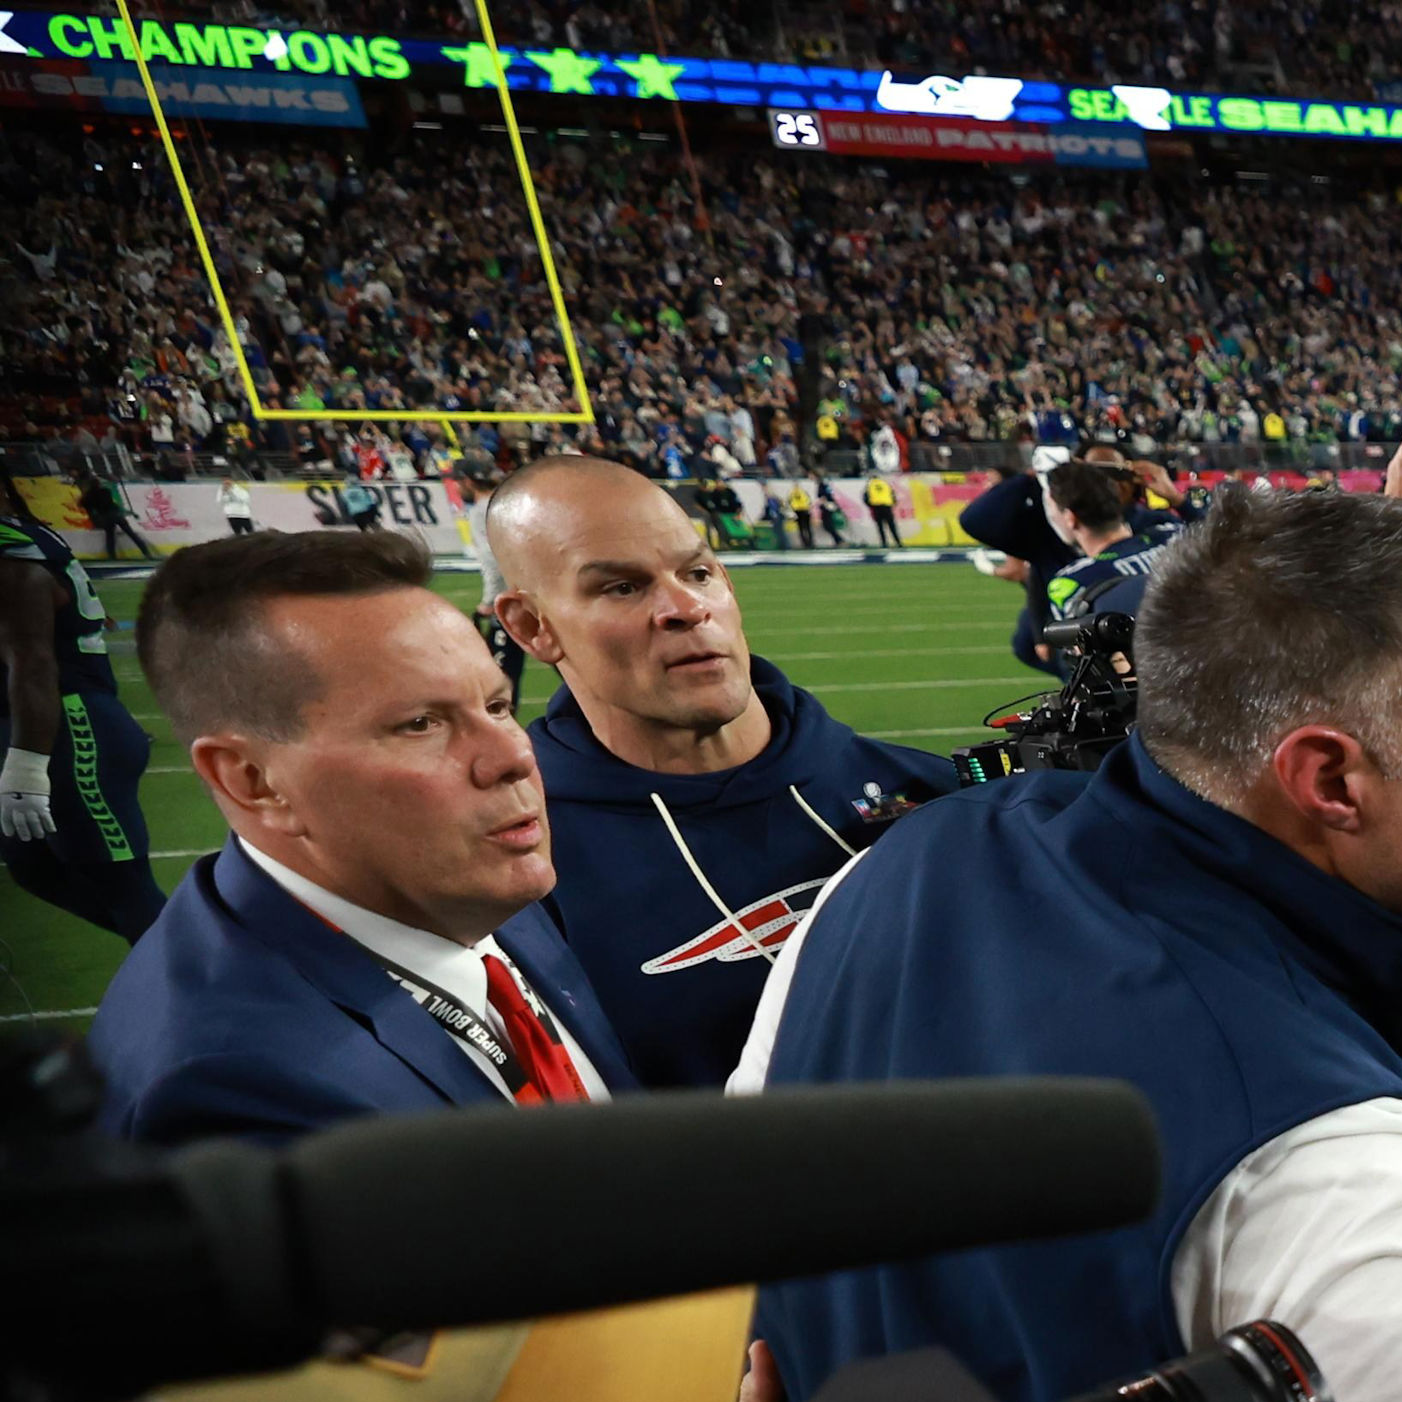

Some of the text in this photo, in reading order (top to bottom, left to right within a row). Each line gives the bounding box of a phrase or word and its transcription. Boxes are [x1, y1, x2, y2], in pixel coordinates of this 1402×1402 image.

[30, 73, 351, 114] SEAHAWKS
[776, 113, 822, 146] 25
[827, 121, 1145, 159] NEW ENGLAND PATRIOTS
[427, 994, 474, 1030] BOWL
[466, 1023, 509, 1066] SUPER
